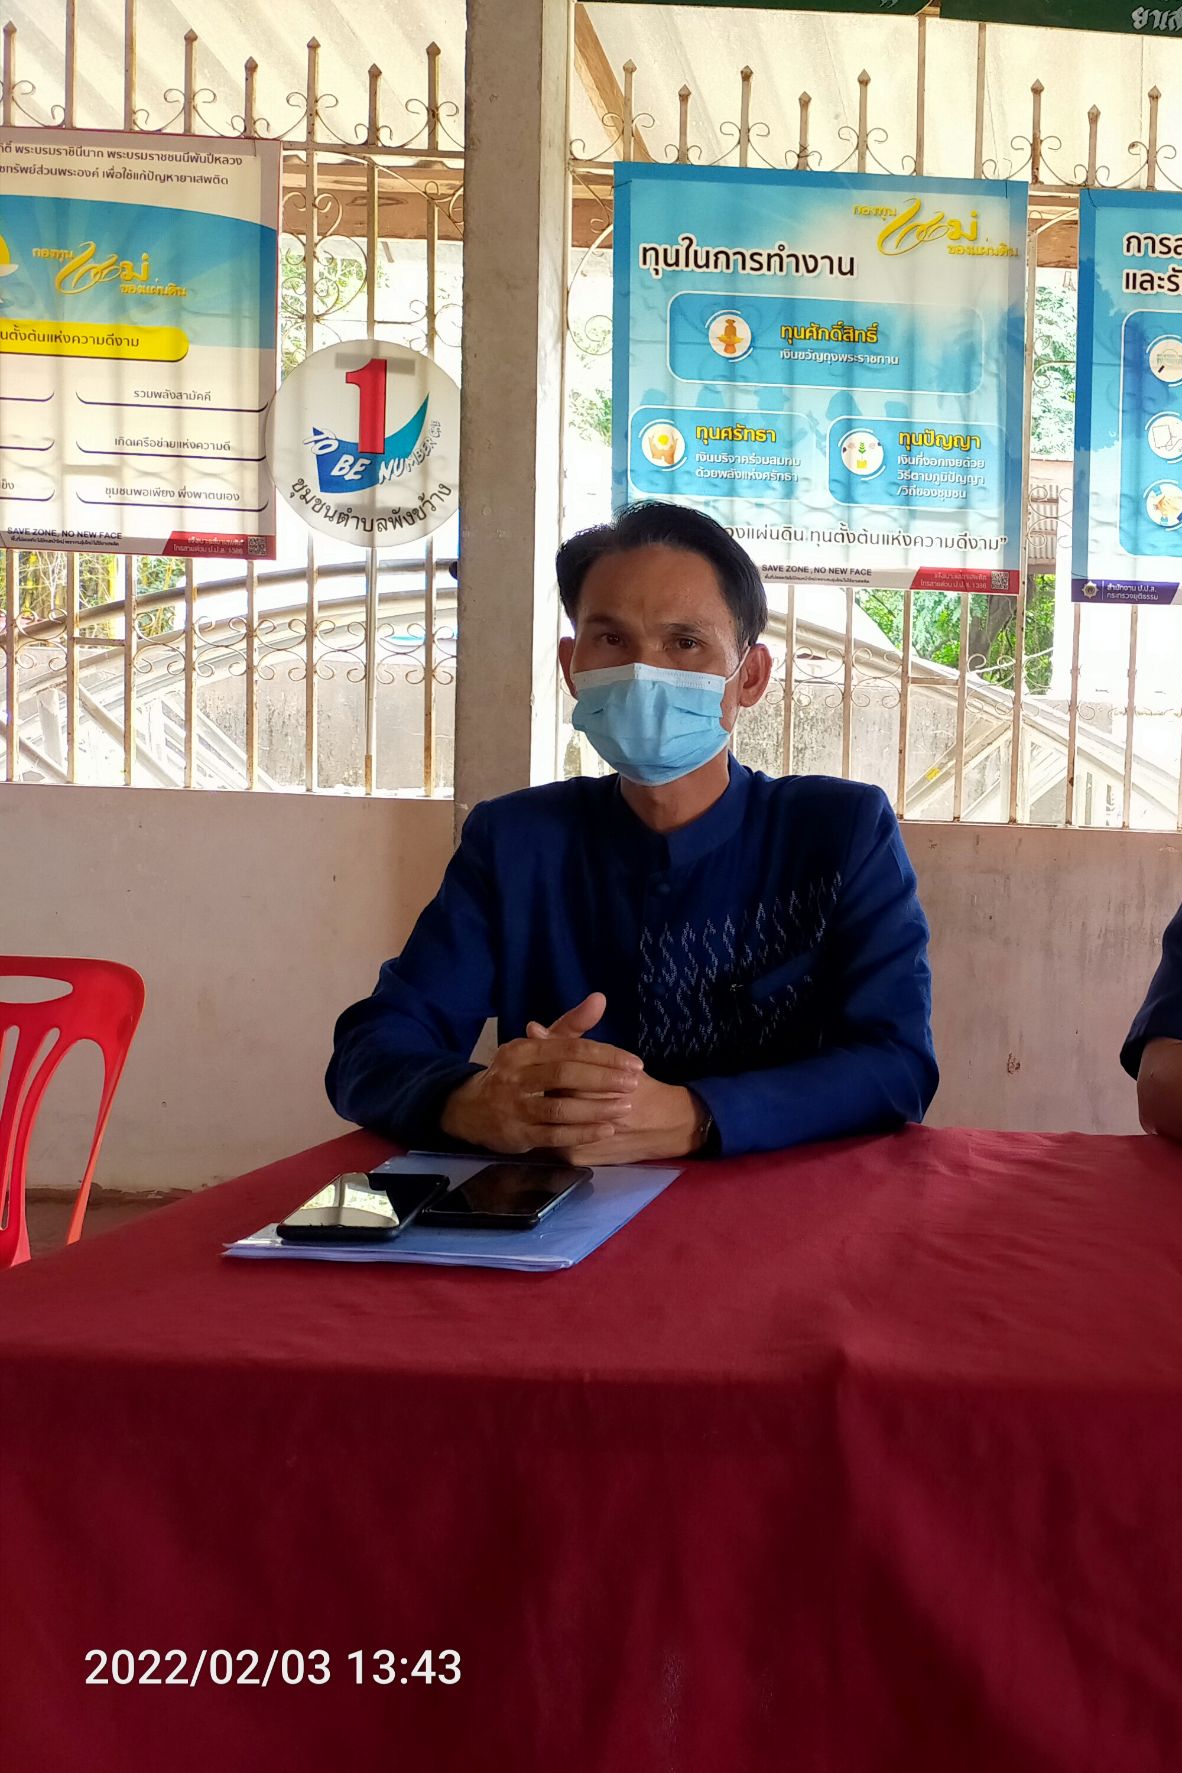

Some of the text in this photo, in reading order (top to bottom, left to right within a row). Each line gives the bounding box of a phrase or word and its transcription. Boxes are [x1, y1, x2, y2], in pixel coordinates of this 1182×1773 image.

[102, 167, 229, 186] เพื่อใช้แก้ปัญหายาเสพติด
[640, 236, 856, 277] ทุนในการทำงาน
[780, 320, 880, 345] ทุนศักดิ์สิทธิ์
[779, 349, 900, 366] เงินขวัญถุงพระราชทาน
[133, 388, 212, 402] รวมพลังสามัคคี
[344, 358, 387, 455] 1
[695, 422, 777, 445] ทุนศรัทธา
[898, 429, 982, 451] ทุนปัญญา
[330, 454, 371, 481] BE
[289, 478, 453, 533] ชุมชนตำบลพังขว้าง
[7, 526, 31, 535] SAVE
[61, 529, 75, 538] NO
[76, 531, 97, 539] NEW
[99, 531, 123, 540] FACE
[761, 564, 784, 573] SAVE
[813, 566, 827, 575] NO
[828, 567, 849, 576] NEW
[849, 567, 872, 577] FACE
